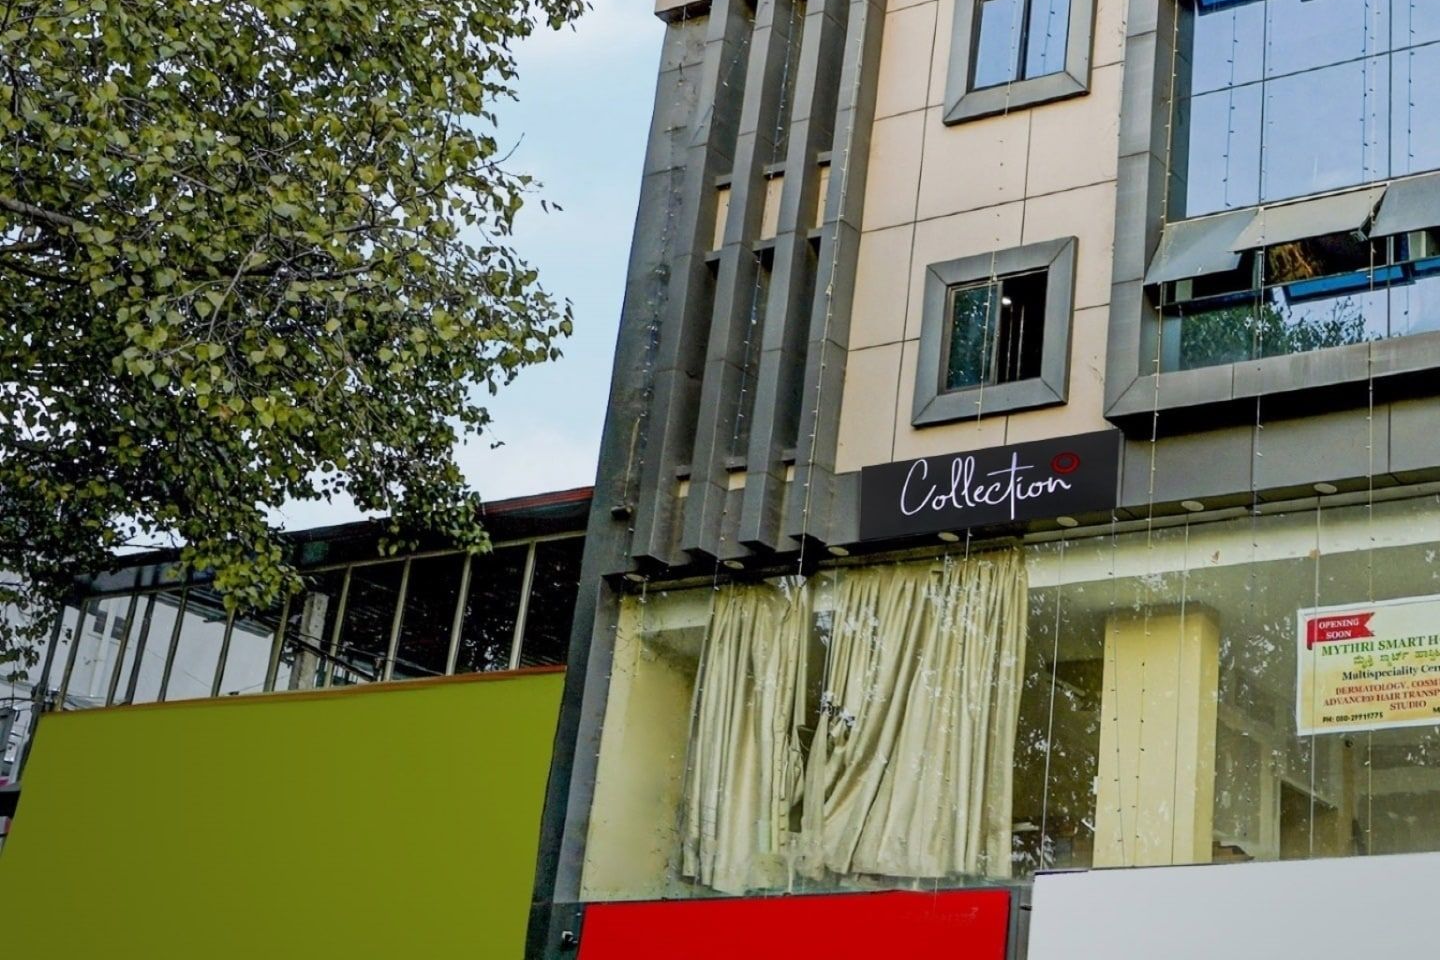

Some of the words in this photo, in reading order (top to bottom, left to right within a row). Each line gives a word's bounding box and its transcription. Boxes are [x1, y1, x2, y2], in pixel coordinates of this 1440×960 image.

[900, 451, 1072, 520] Collection
[1318, 618, 1360, 630] OPENING
[1325, 629, 1352, 640] SOON
[1321, 642, 1375, 657] MYTHRI
[1378, 636, 1426, 652] SMART
[1341, 664, 1418, 681] Multispeciality
[1323, 692, 1374, 707] ADVANCED
[1376, 690, 1401, 703] HAIR
[1389, 699, 1427, 712] STUDIO
